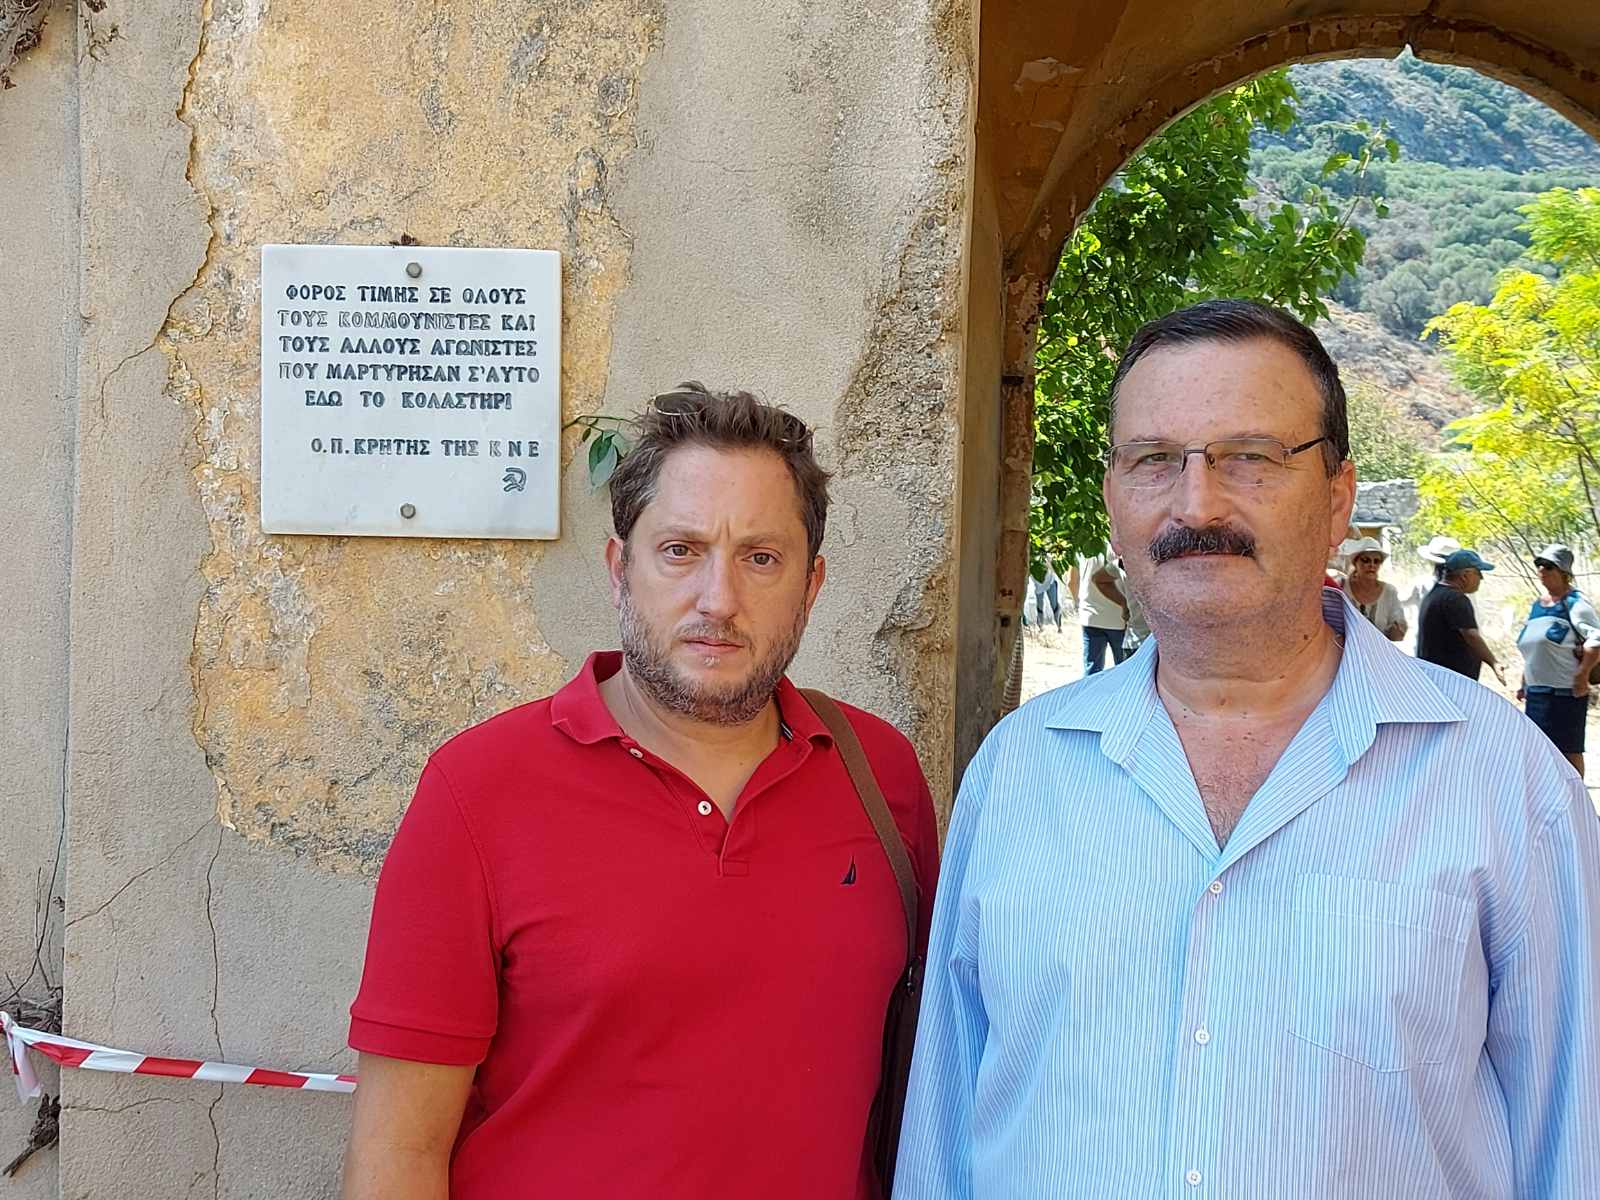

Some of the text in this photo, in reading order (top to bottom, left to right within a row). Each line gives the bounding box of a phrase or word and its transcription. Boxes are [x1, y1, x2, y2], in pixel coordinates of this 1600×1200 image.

[286, 285, 526, 304] ΦΟΡΟΣ ΤΙΜΗΣ ΣΕ ΟΛΟΥΣ
[278, 310, 536, 331] ΤΟΥΣ ΚΟΜΜΟΥΝΙΣΤΕΣ ΚΑΙ
[279, 336, 537, 356] ΤΟΥΣ ΑΛΛΟΥΣ ΑΓΩΝΙΣΤΕΣ
[279, 363, 318, 379] ΠΟΥ
[326, 363, 460, 381] ΜΑΡΤΥΡΗΣΑΝ
[305, 391, 512, 410] ΕΔΩ ΤΟ ΚΟΛΑΣΤΗΡΙ
[441, 440, 479, 456] ΤΗΣ
